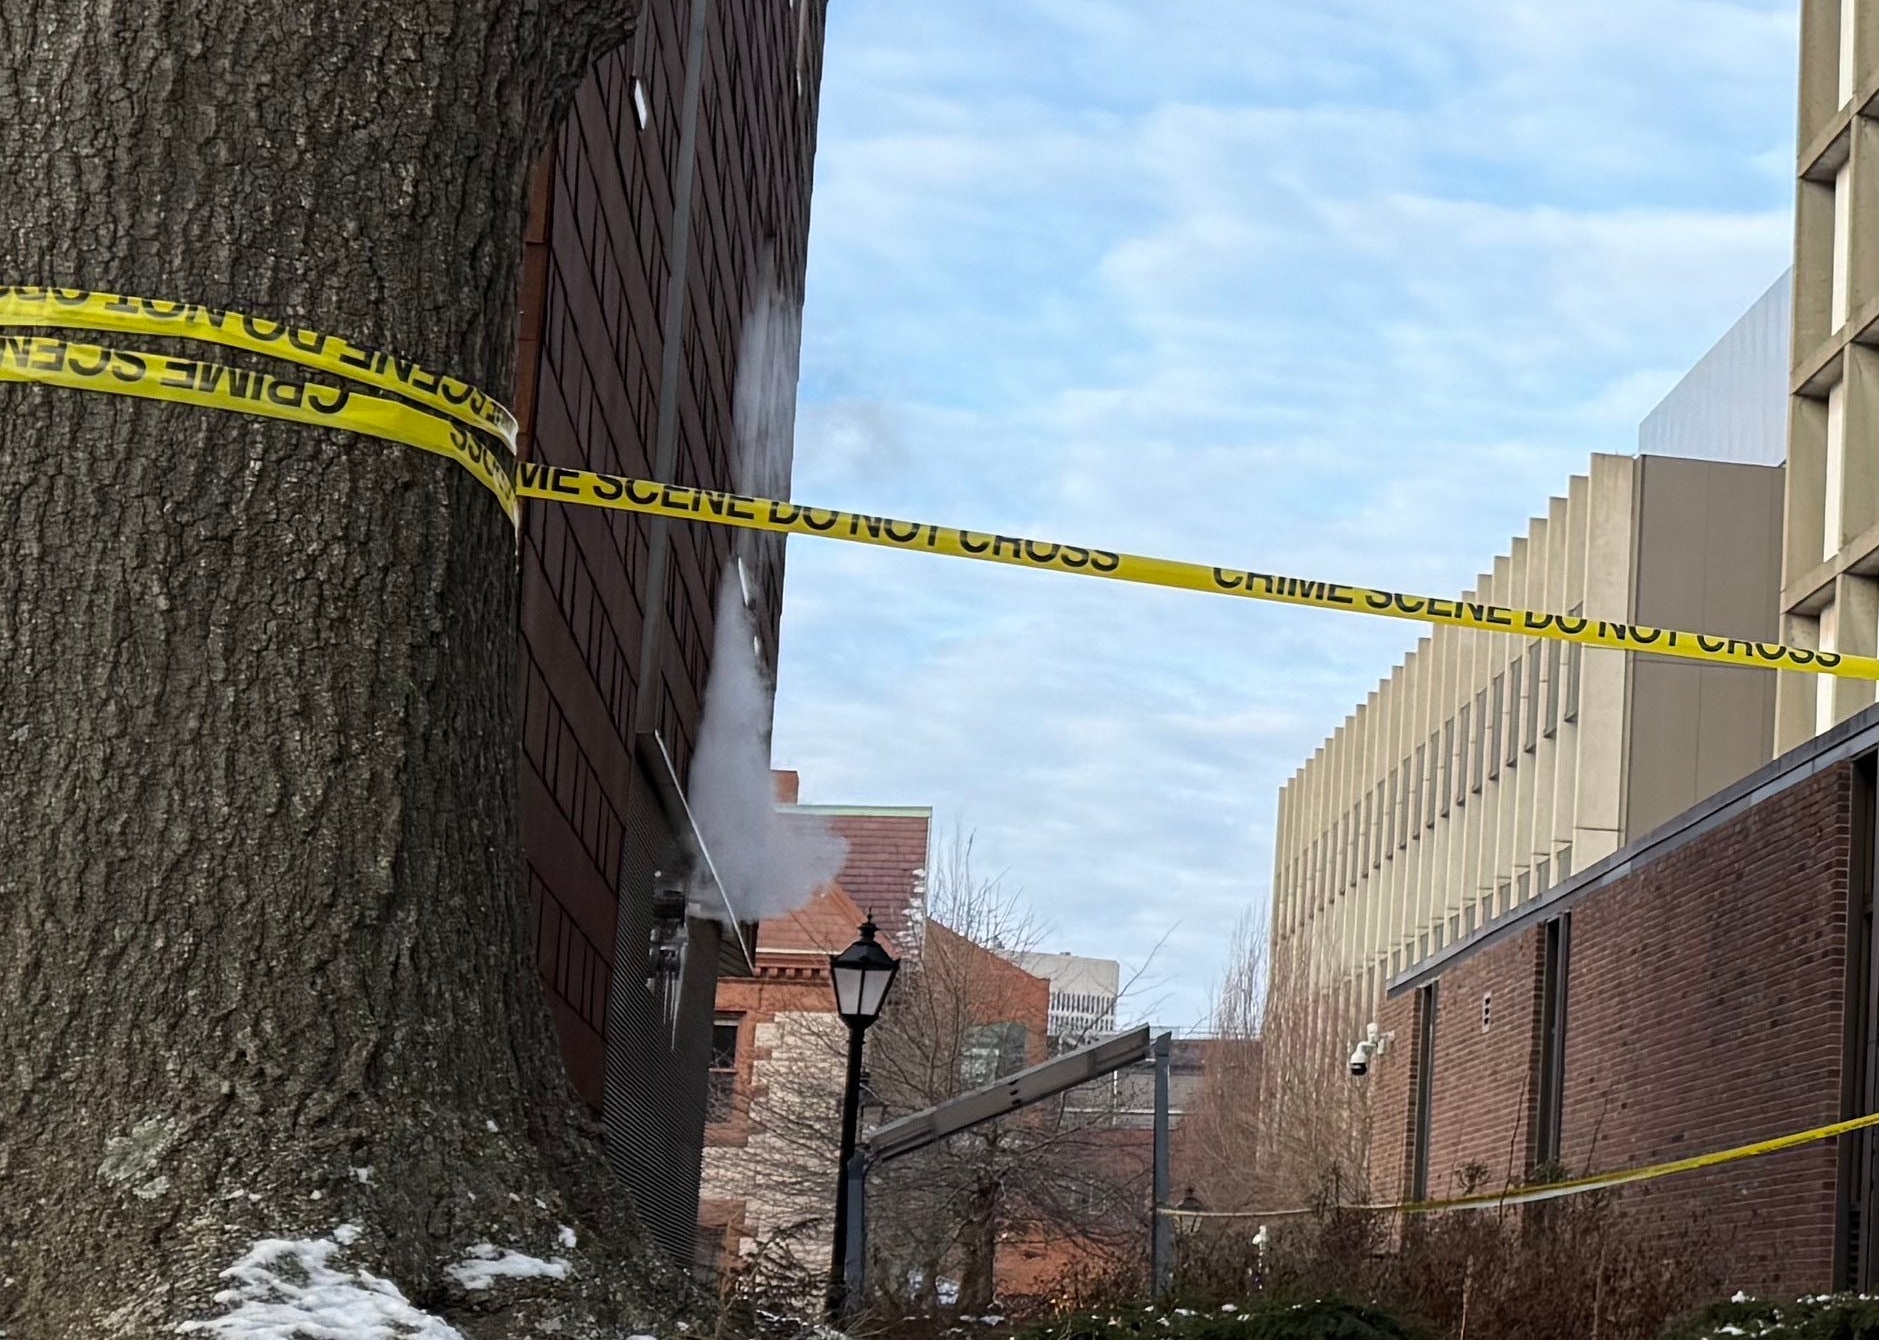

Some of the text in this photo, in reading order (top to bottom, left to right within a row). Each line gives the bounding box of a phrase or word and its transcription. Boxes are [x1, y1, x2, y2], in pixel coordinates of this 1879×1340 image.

[160, 359, 350, 415] CRIME
[592, 472, 754, 520] SCENE
[767, 500, 837, 532] DO
